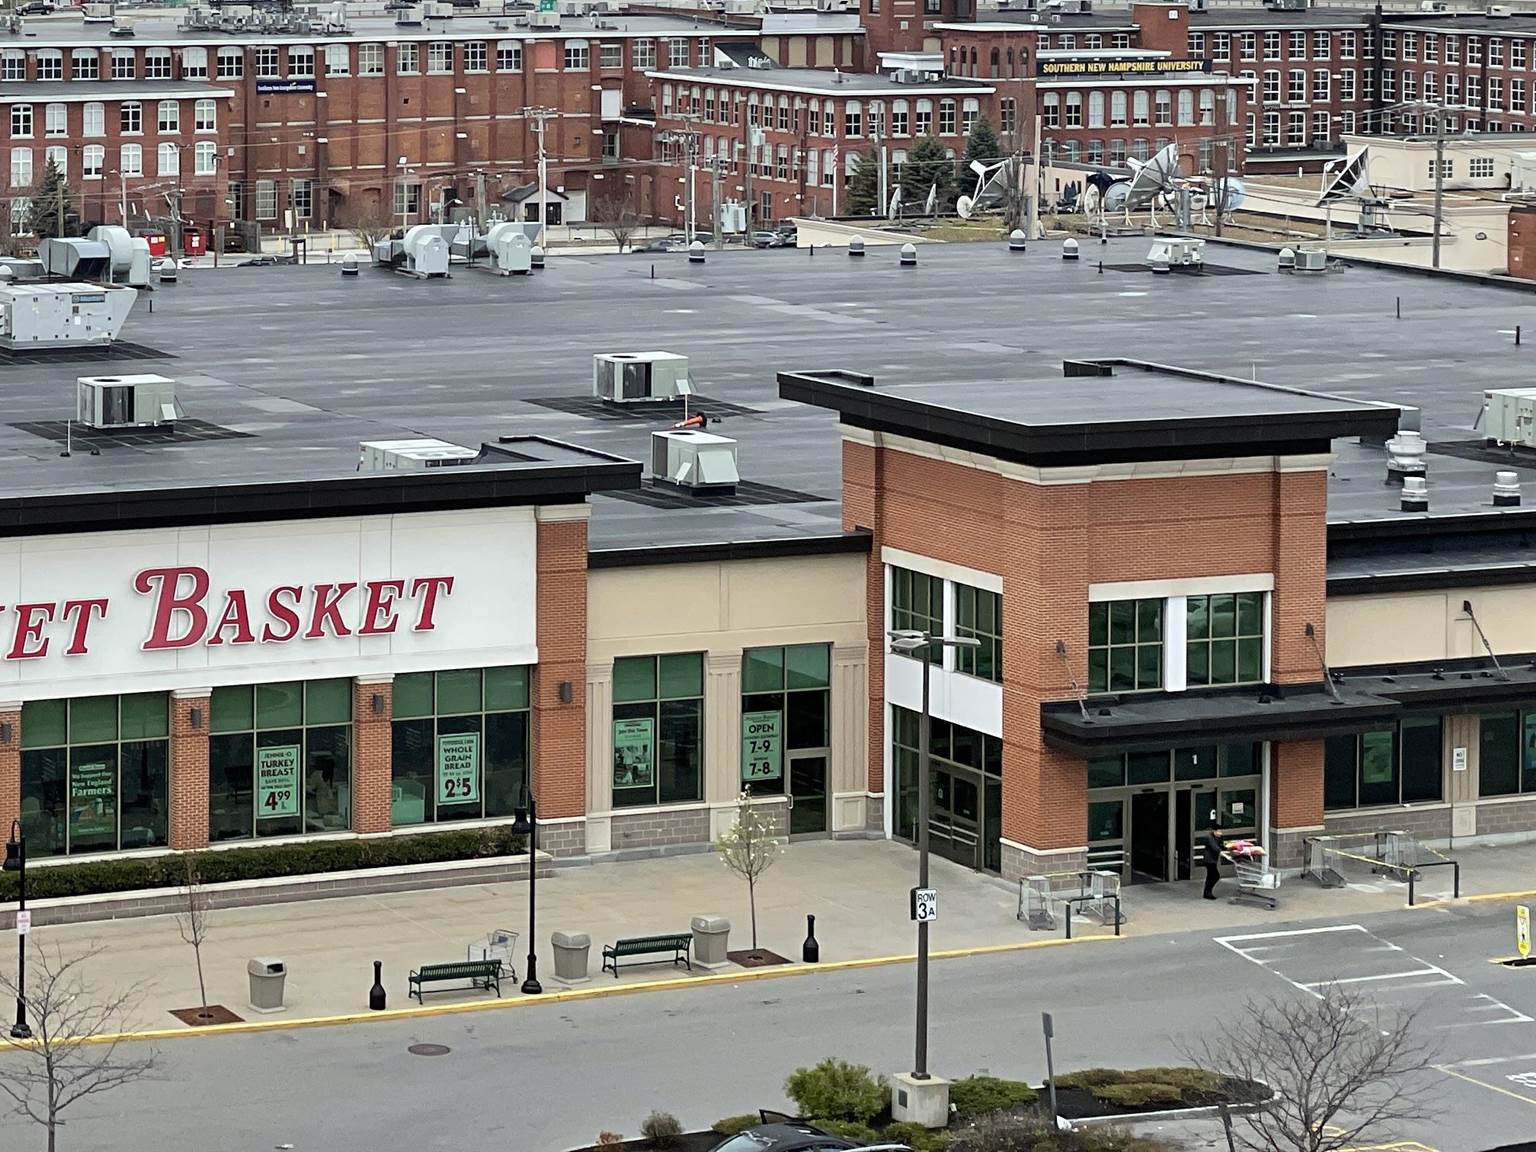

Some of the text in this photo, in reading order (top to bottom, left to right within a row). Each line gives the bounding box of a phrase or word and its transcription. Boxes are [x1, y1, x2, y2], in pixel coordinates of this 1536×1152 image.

[1042, 60, 1204, 74] SOUTHERN NEW HAMPSHIRE UNIVERSITY
[133, 565, 454, 650] BASKET
[749, 723, 774, 733] OPEN
[443, 746, 472, 754] WHOLE
[750, 740, 770, 753] 7-9
[445, 754, 472, 762] GRAIN
[1192, 754, 1198, 765] 1
[261, 759, 295, 769] TURKEY
[445, 762, 471, 770] BREAD
[749, 762, 770, 776] 7-8
[261, 768, 295, 777] BREAST
[87, 779, 112, 787] England
[72, 787, 112, 797] Farmers
[917, 893, 936, 903] ROW
